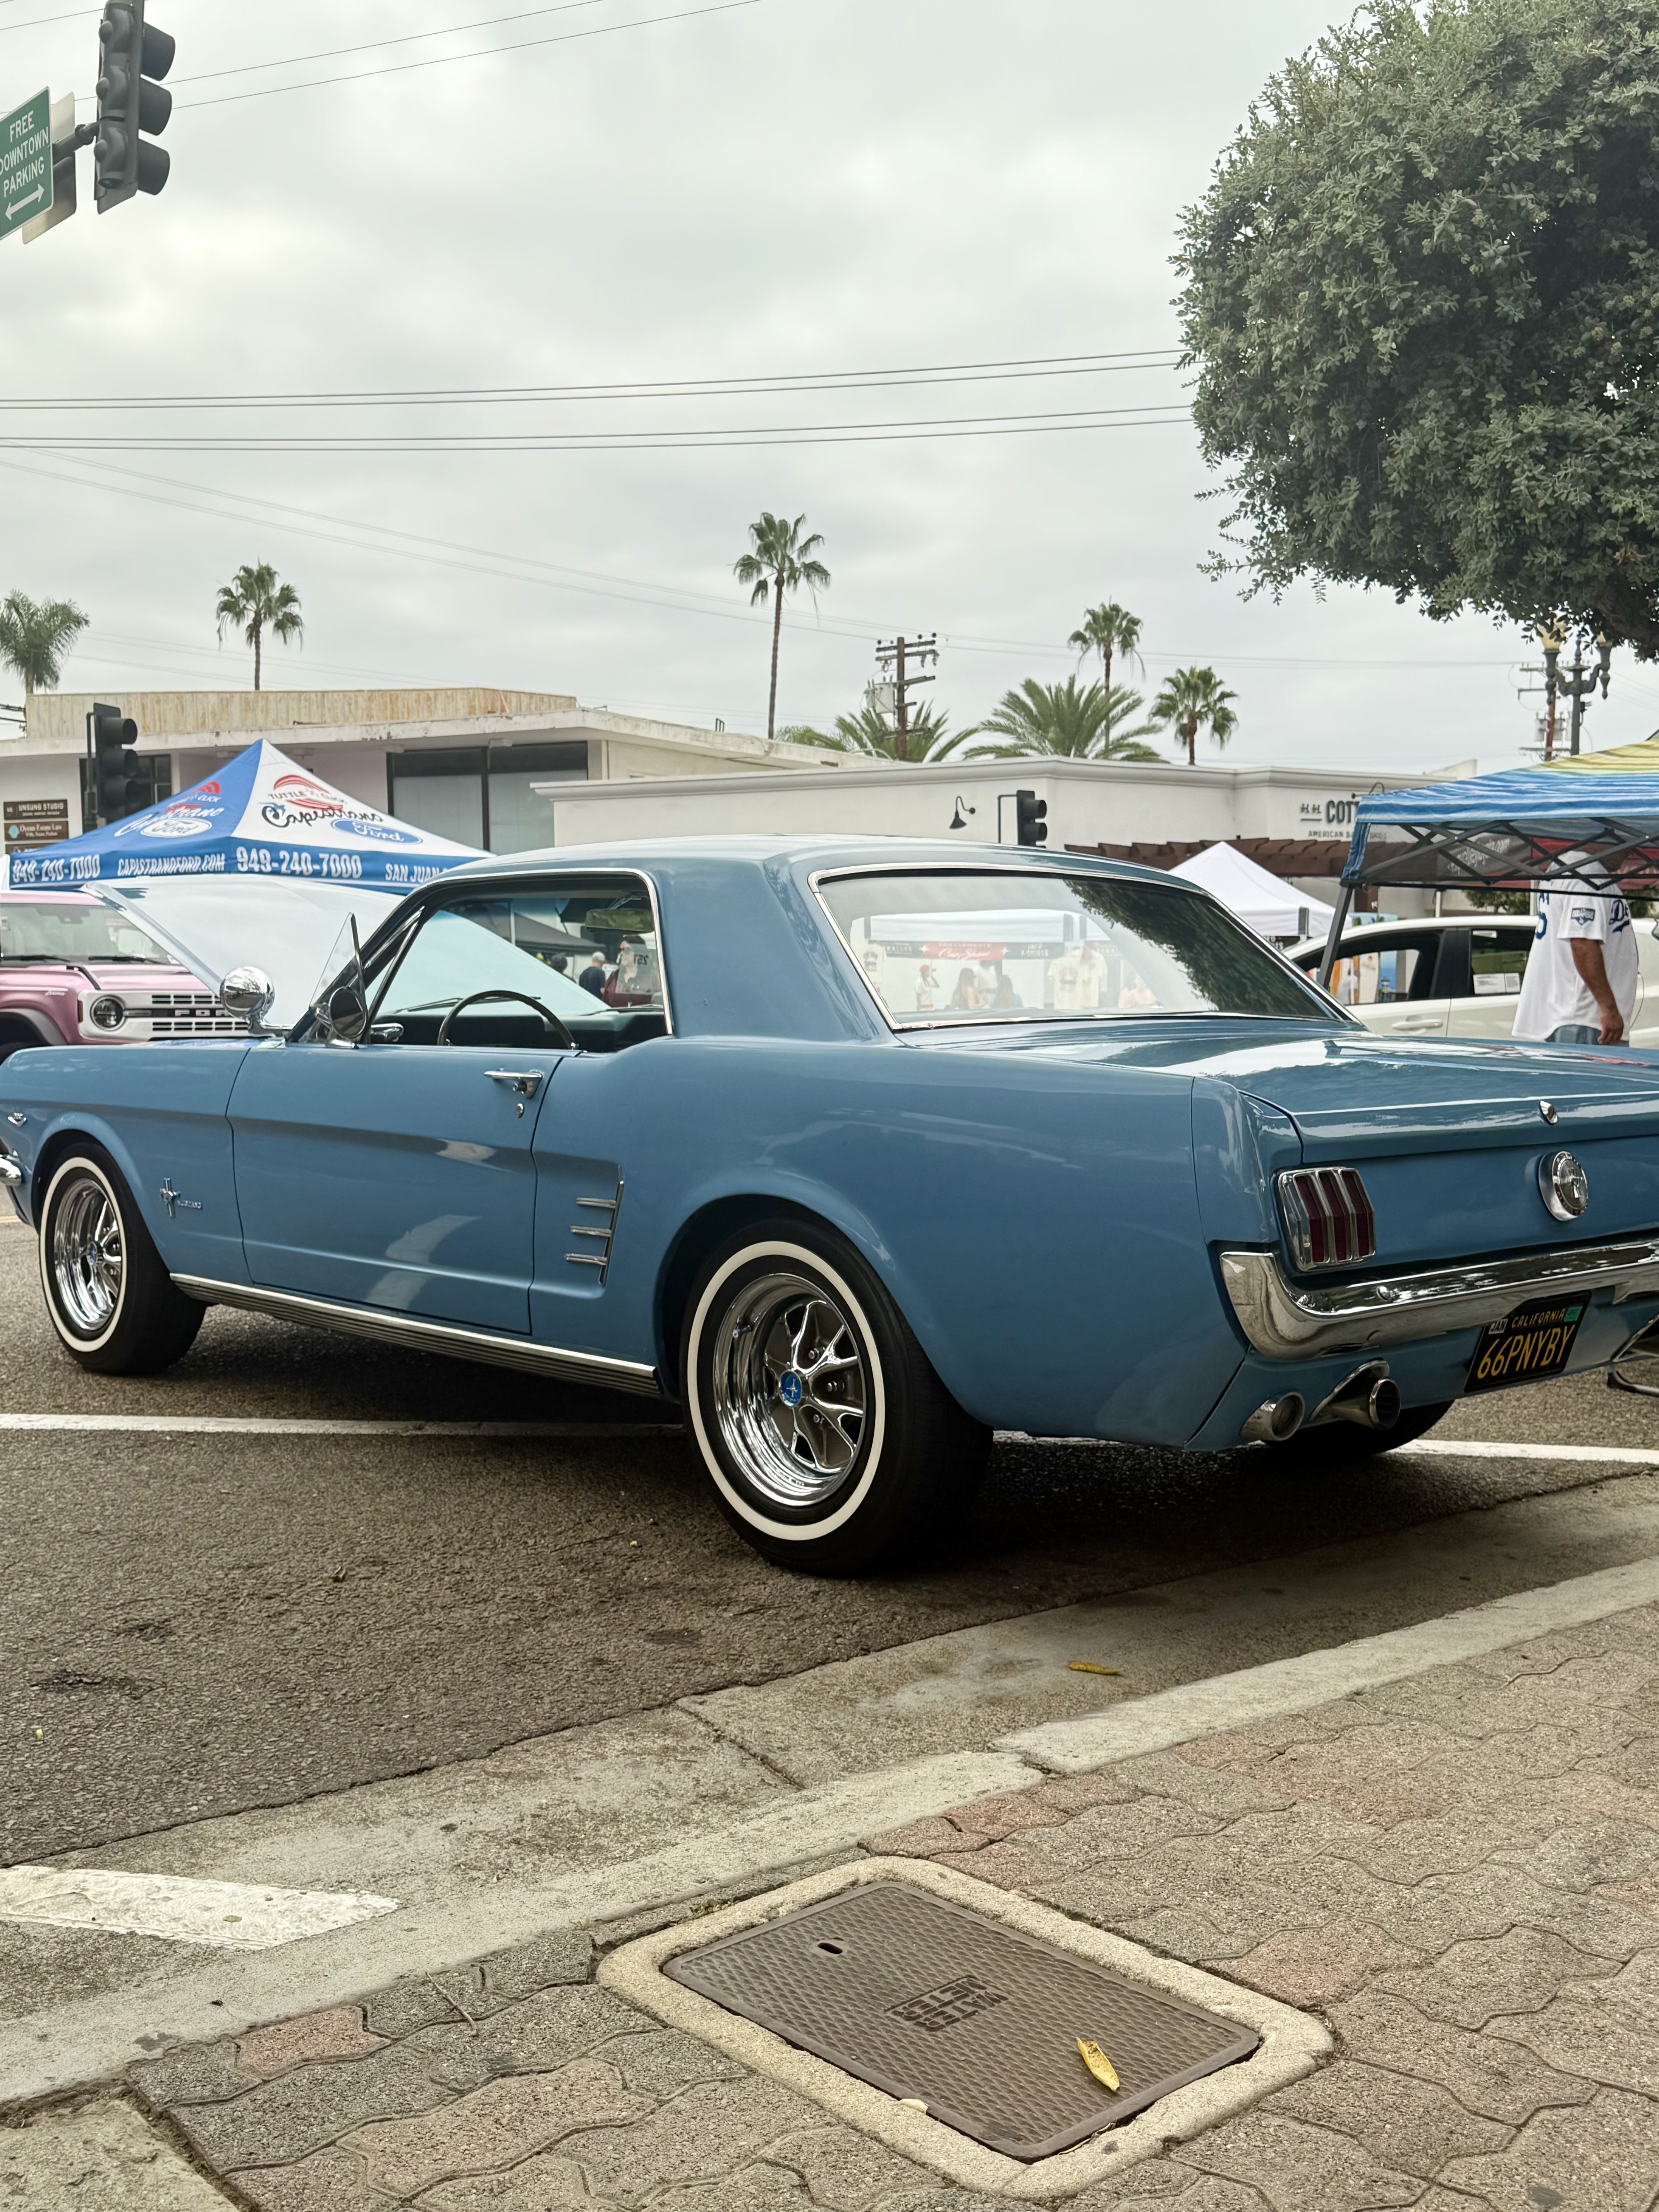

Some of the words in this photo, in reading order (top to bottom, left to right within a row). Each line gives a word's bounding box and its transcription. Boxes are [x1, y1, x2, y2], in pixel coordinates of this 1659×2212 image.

[10, 110, 34, 143] FREE
[3, 156, 44, 198] PARKING
[19, 803, 42, 812] UNSUNG
[43, 802, 64, 810] STUDIO
[268, 791, 307, 800] TUTTLE
[152, 820, 199, 834] Ford
[352, 822, 405, 842] Ford
[12, 854, 101, 883] 949-240-7000
[117, 853, 225, 876] CAPISTRANOFORD.COM
[236, 847, 363, 879] 949-240-7000
[385, 863, 408, 882] SAN
[1491, 1318, 1508, 1332] JAN
[1511, 1308, 1566, 1328] CALIFORNIA
[1477, 1324, 1576, 1379] 66PNYBY
[890, 1979, 988, 2021] METER
[913, 1990, 1009, 2032] WATER
